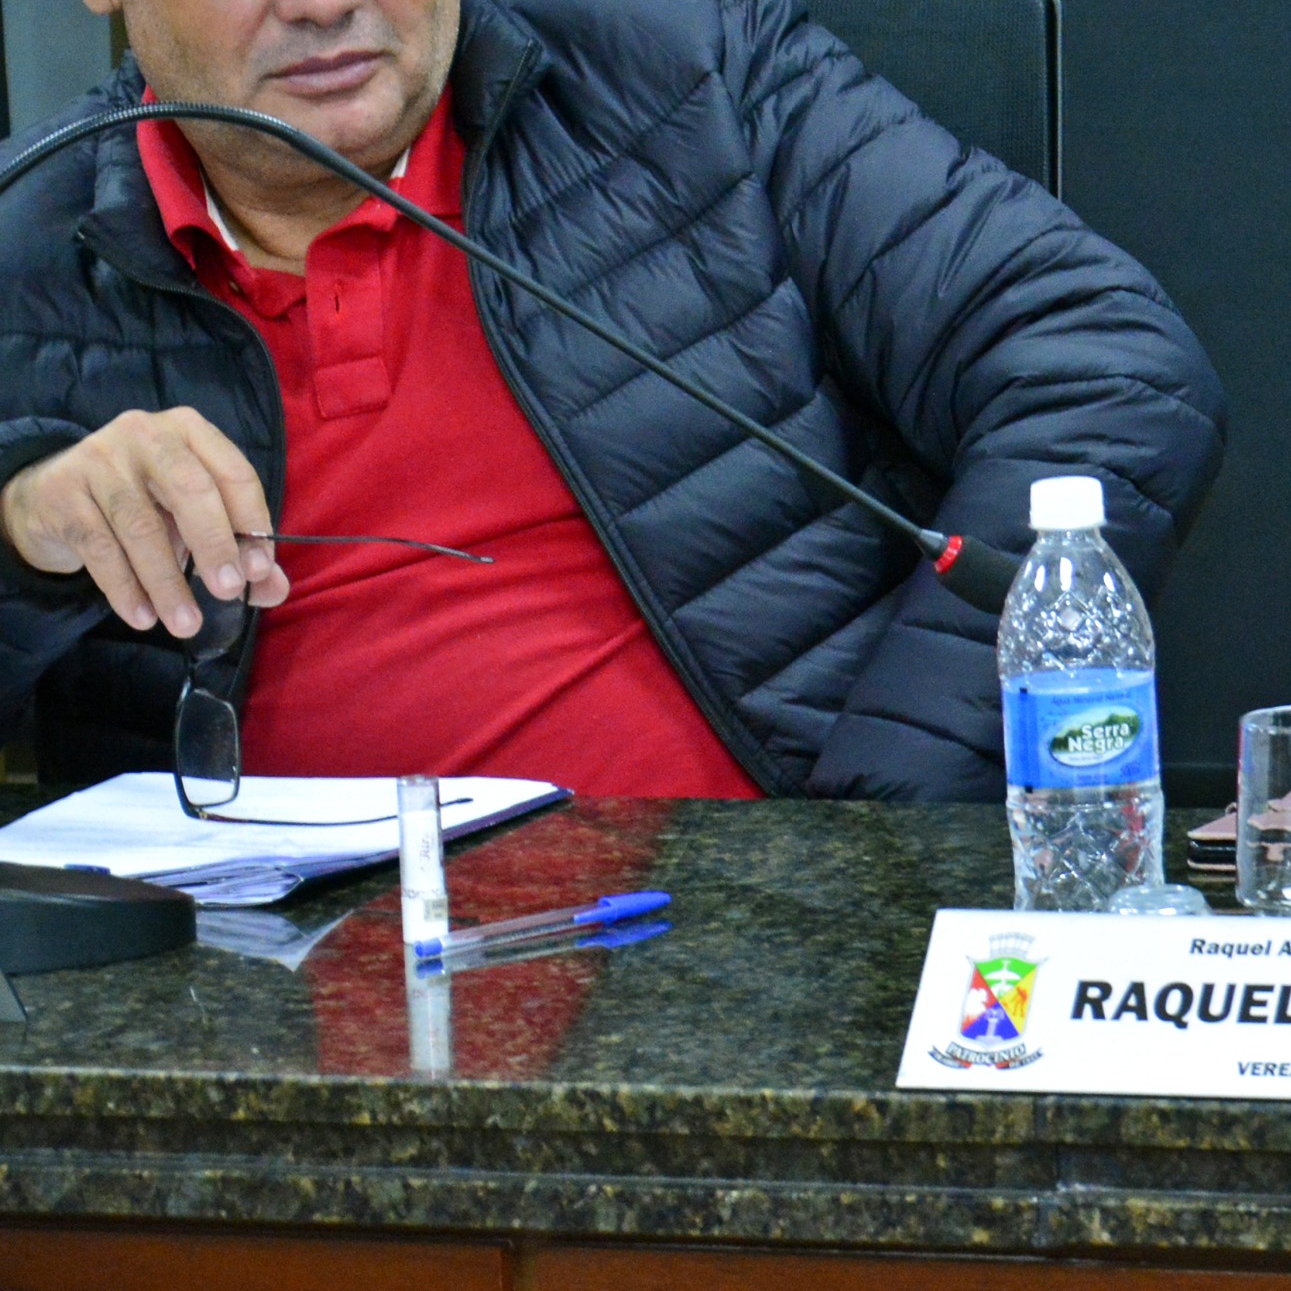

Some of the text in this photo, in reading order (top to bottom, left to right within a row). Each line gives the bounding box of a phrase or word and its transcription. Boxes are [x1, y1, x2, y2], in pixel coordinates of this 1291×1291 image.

[1081, 722, 1131, 740] Serra
[1067, 736, 1125, 755] Negra
[1189, 938, 1272, 959] Raquel
